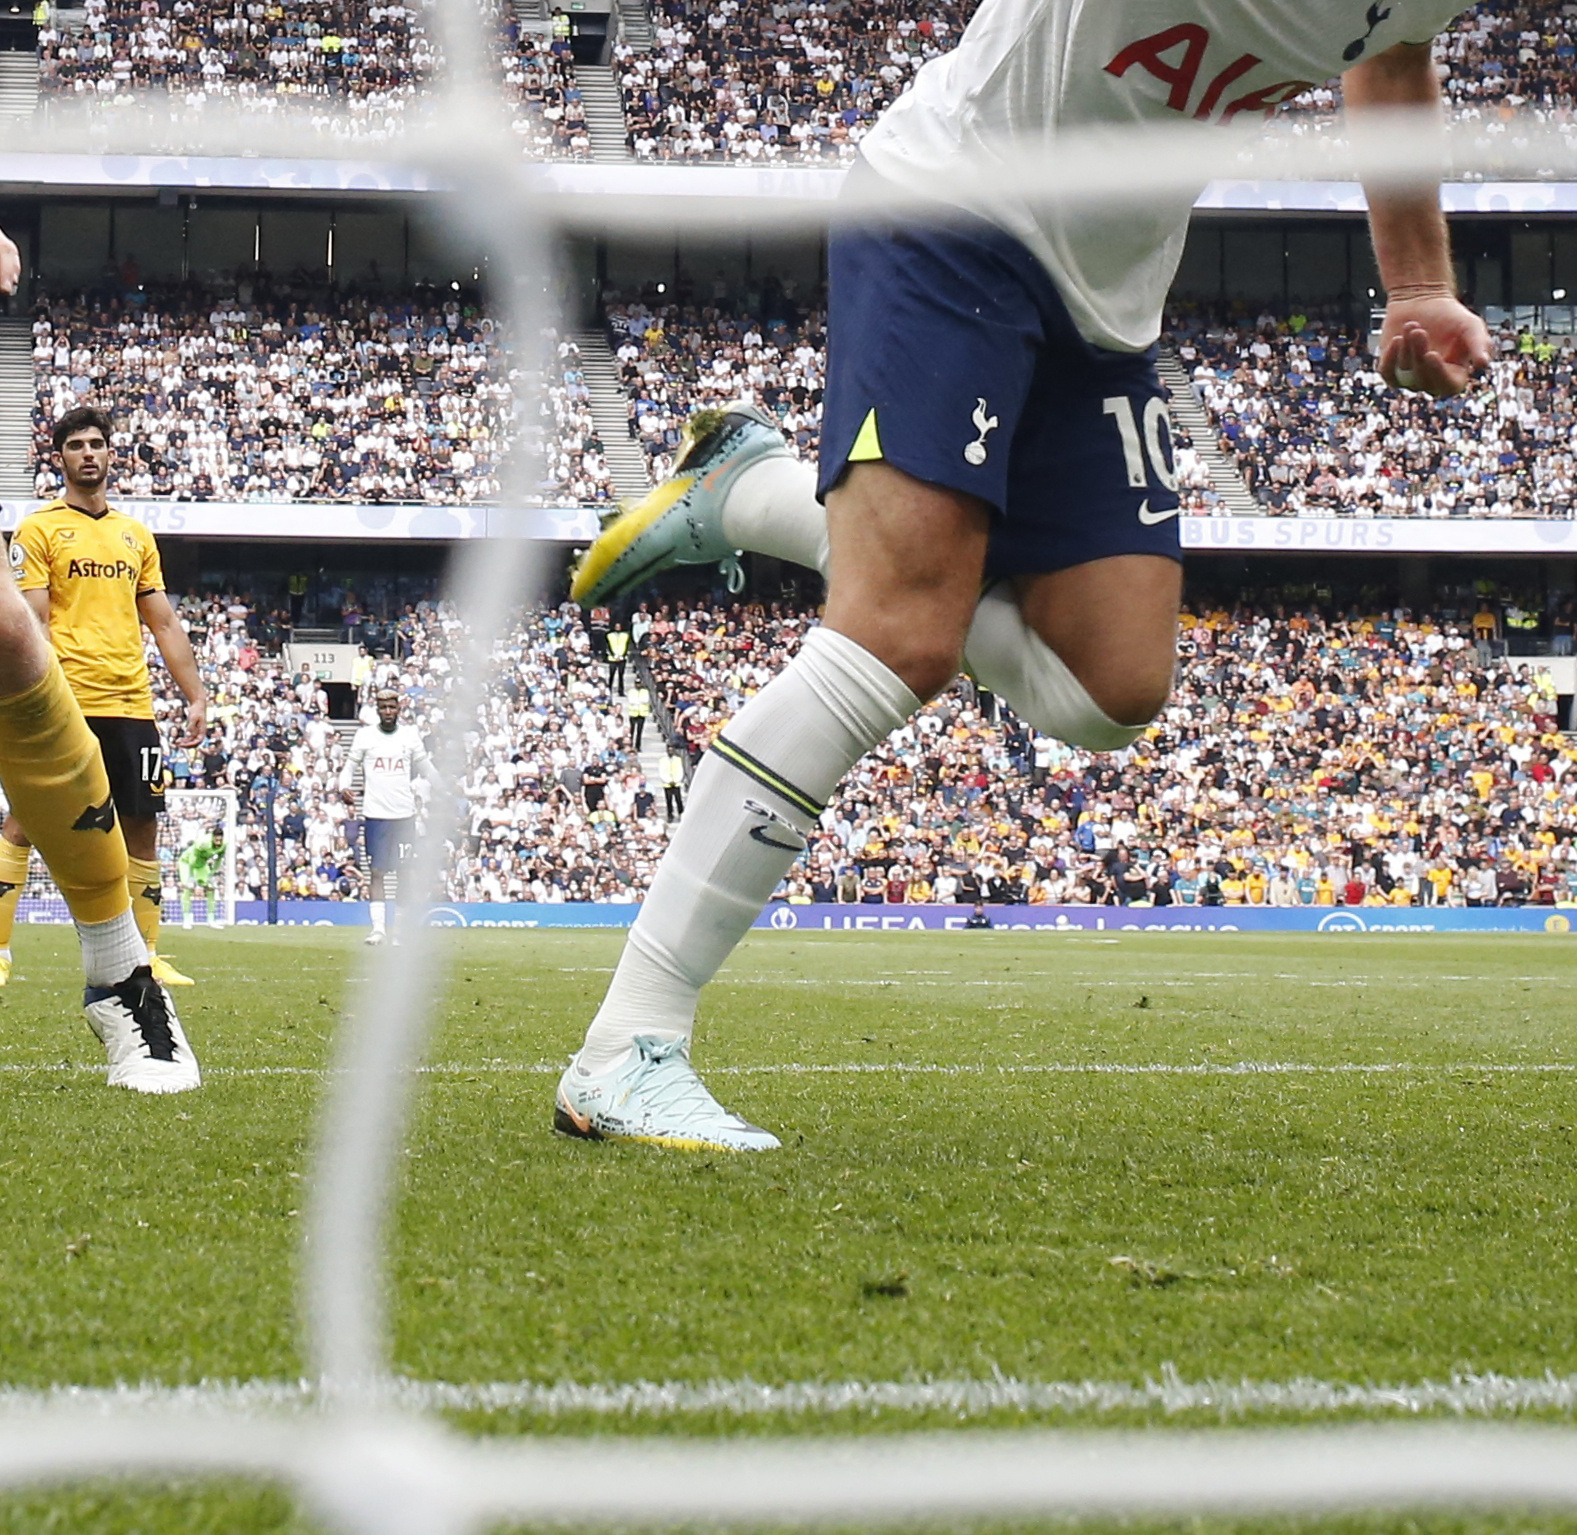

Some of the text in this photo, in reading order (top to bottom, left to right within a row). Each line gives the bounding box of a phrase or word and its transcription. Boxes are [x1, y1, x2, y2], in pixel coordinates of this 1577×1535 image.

[1102, 395, 1179, 493] 10
[1276, 521, 1394, 547] SPURS
[67, 558, 139, 583] AstroPay
[139, 746, 162, 782] 17
[373, 757, 406, 772] AIA
